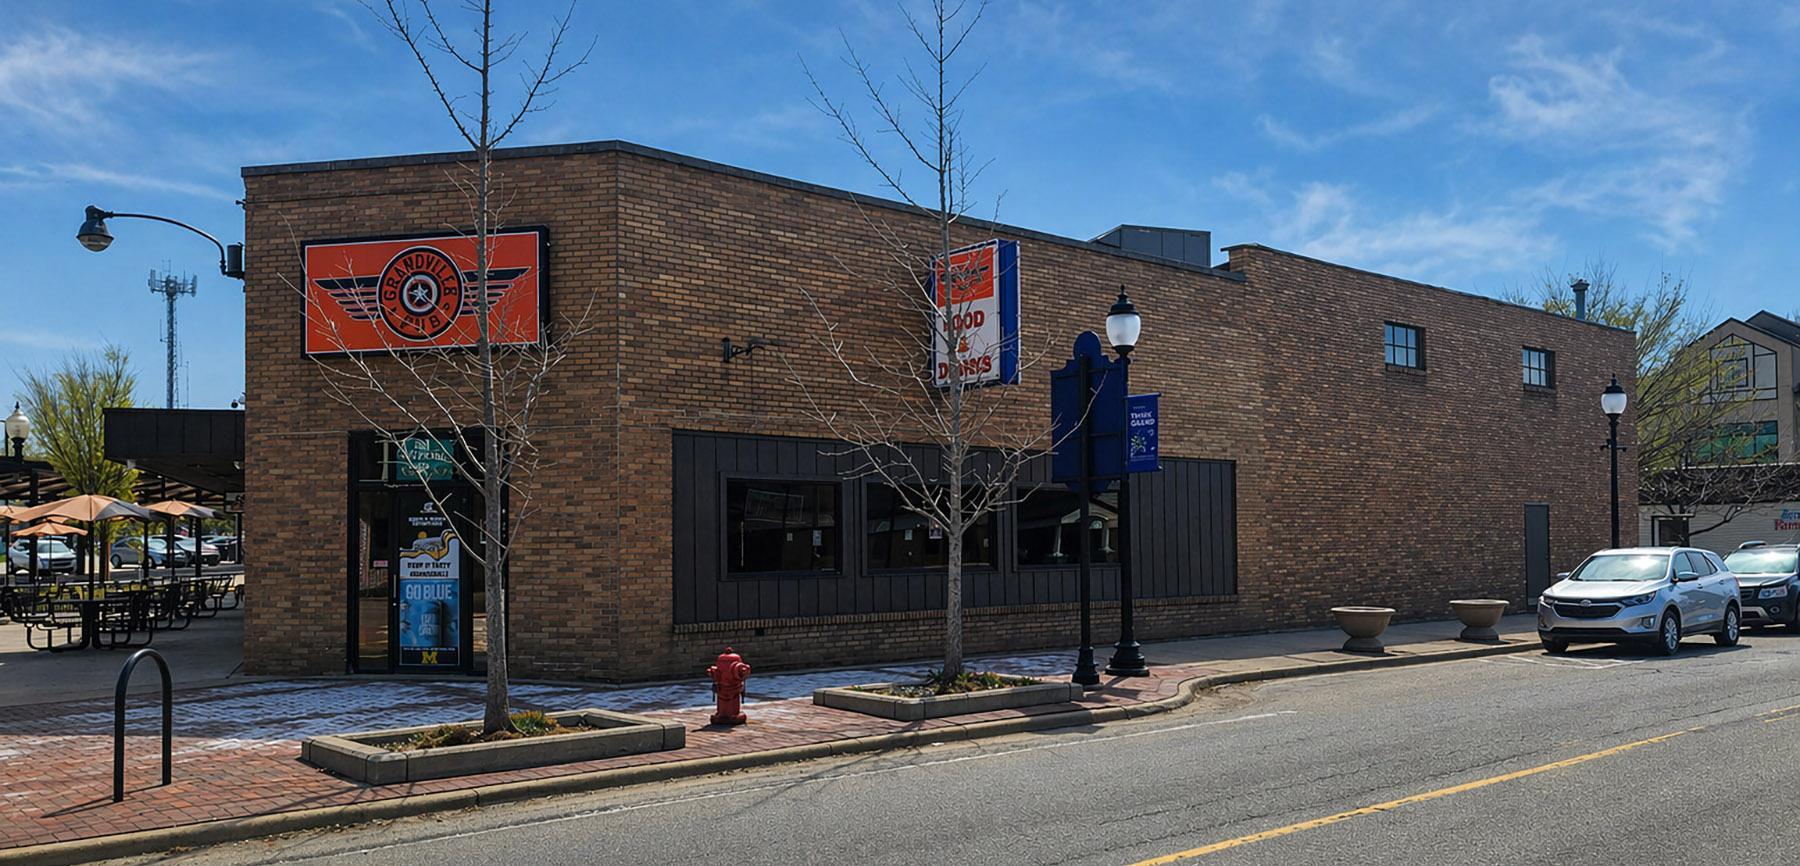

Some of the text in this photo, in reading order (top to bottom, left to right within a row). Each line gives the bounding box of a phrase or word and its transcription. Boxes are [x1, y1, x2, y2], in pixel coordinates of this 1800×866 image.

[406, 584, 453, 600] GO BLUE
[421, 651, 438, 664] M
